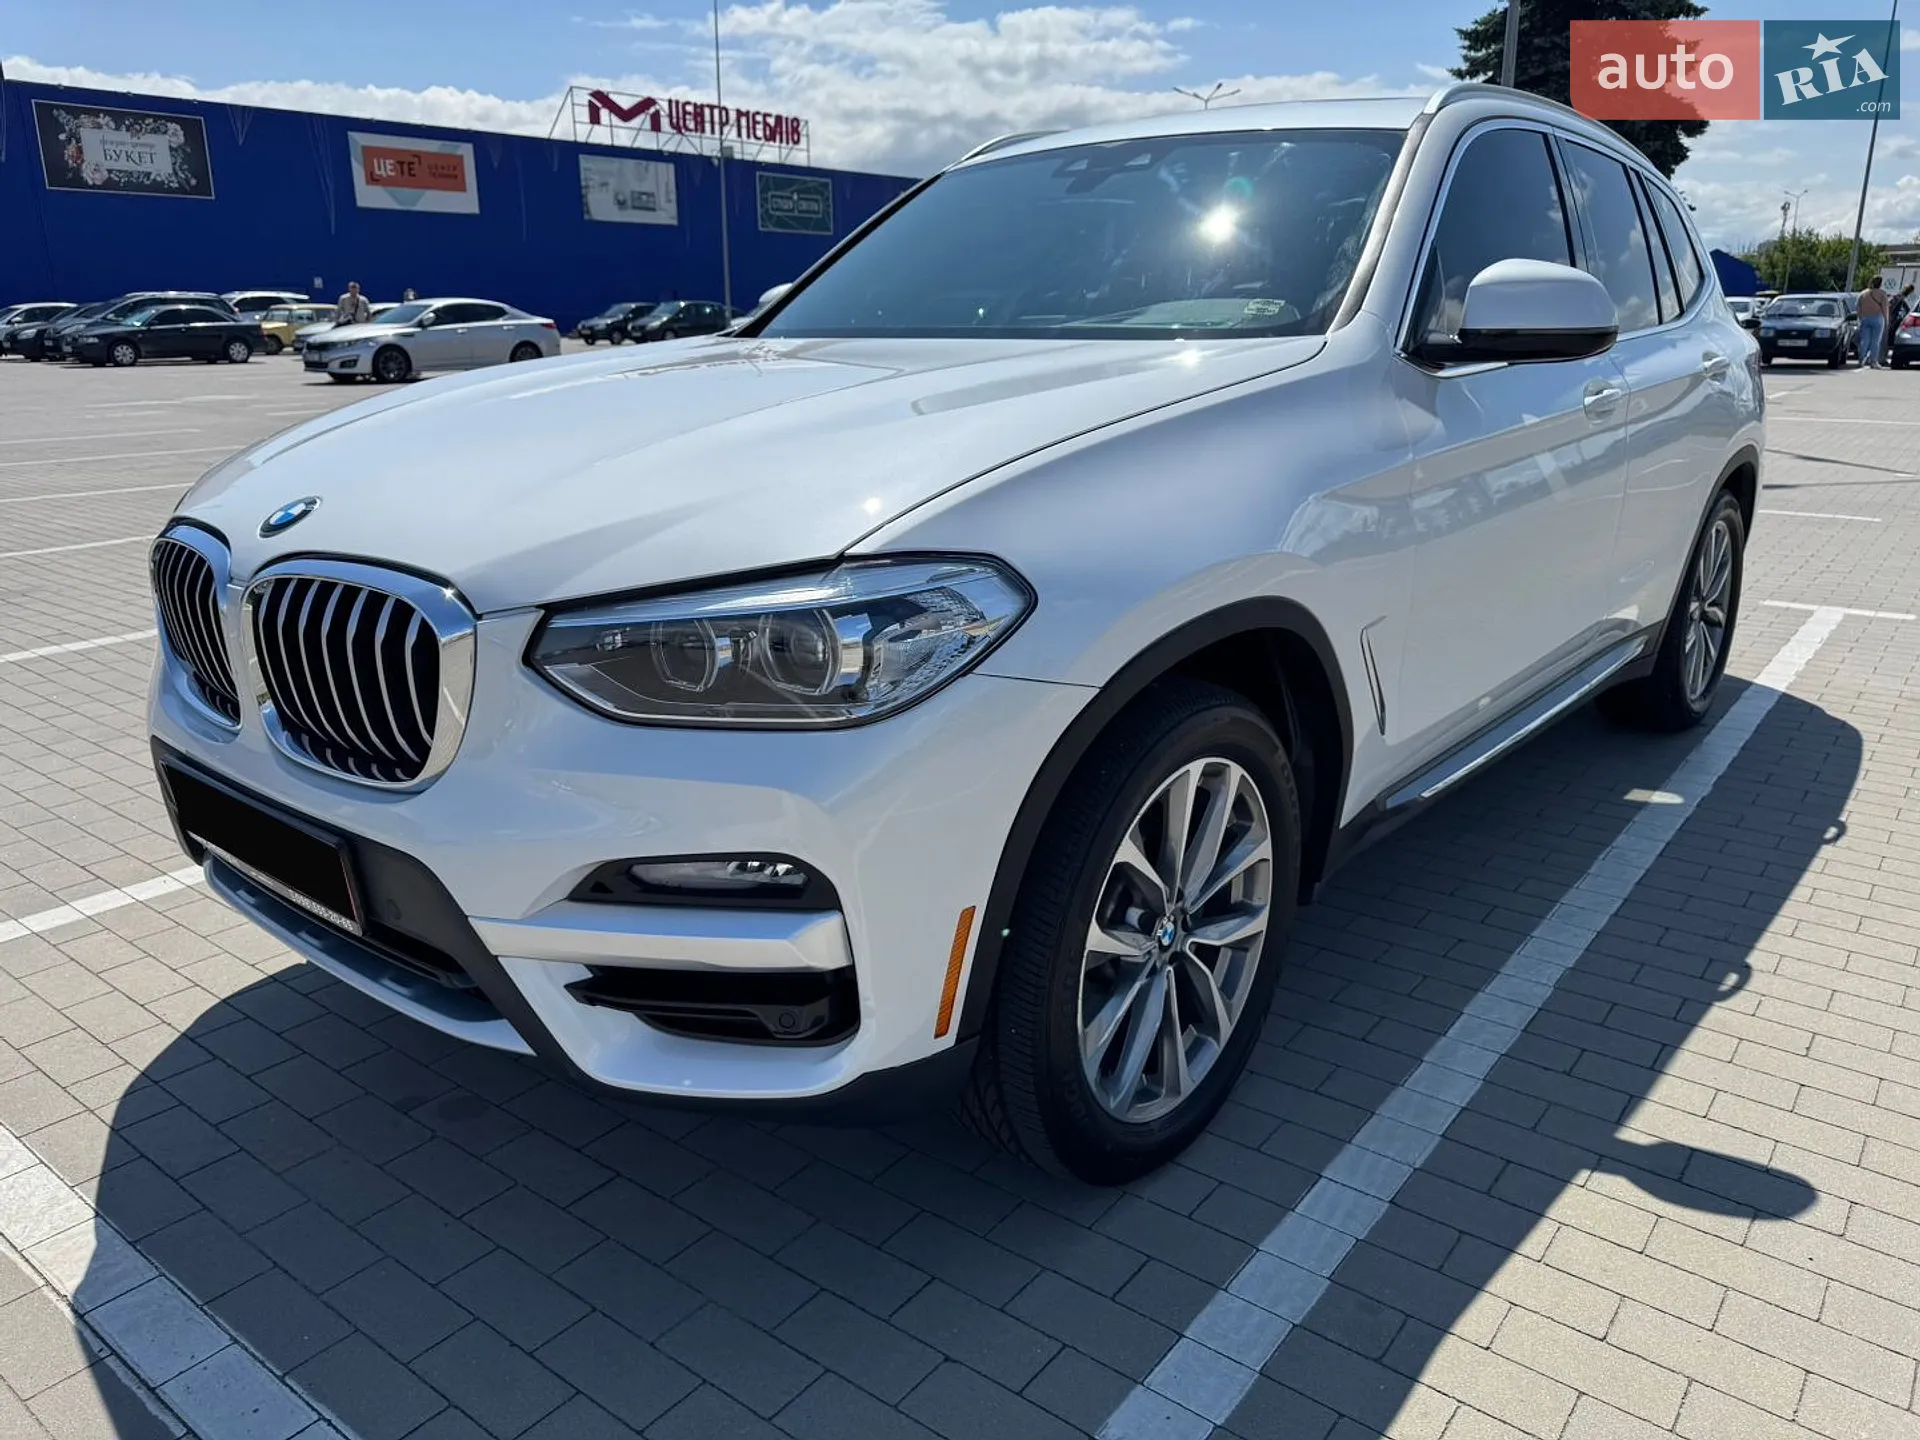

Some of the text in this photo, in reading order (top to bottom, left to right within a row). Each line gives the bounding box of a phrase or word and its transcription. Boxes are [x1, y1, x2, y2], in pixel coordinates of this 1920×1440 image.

[667, 99, 730, 135] ЦЕНТР
[736, 109, 802, 145] МЕБЛІВ
[103, 149, 157, 166] БУКЕТ
